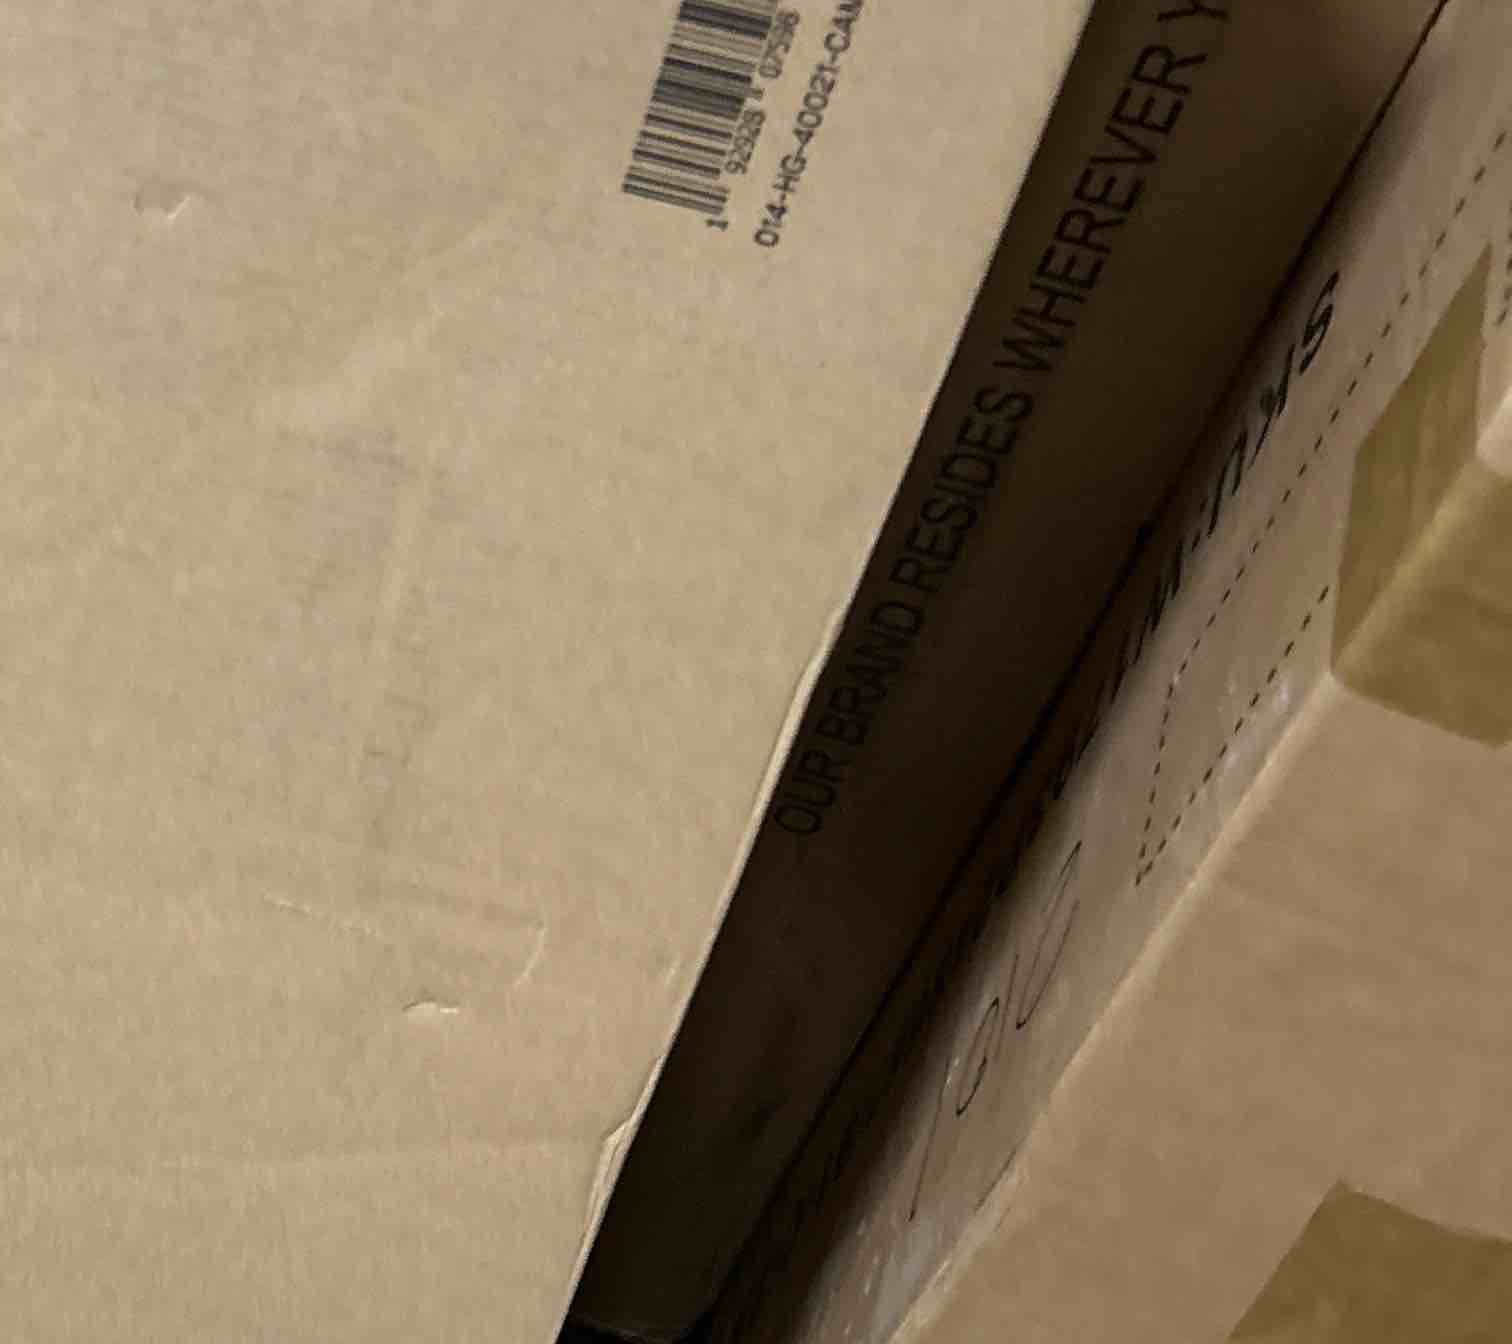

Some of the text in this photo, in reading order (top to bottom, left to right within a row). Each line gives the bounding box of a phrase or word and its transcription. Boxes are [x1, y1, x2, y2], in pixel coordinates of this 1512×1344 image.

[778, 749, 849, 836] OUR
[820, 586, 925, 744] BRAND
[886, 374, 1035, 596] RESIDES
[996, 44, 1206, 376] WHEREVER
